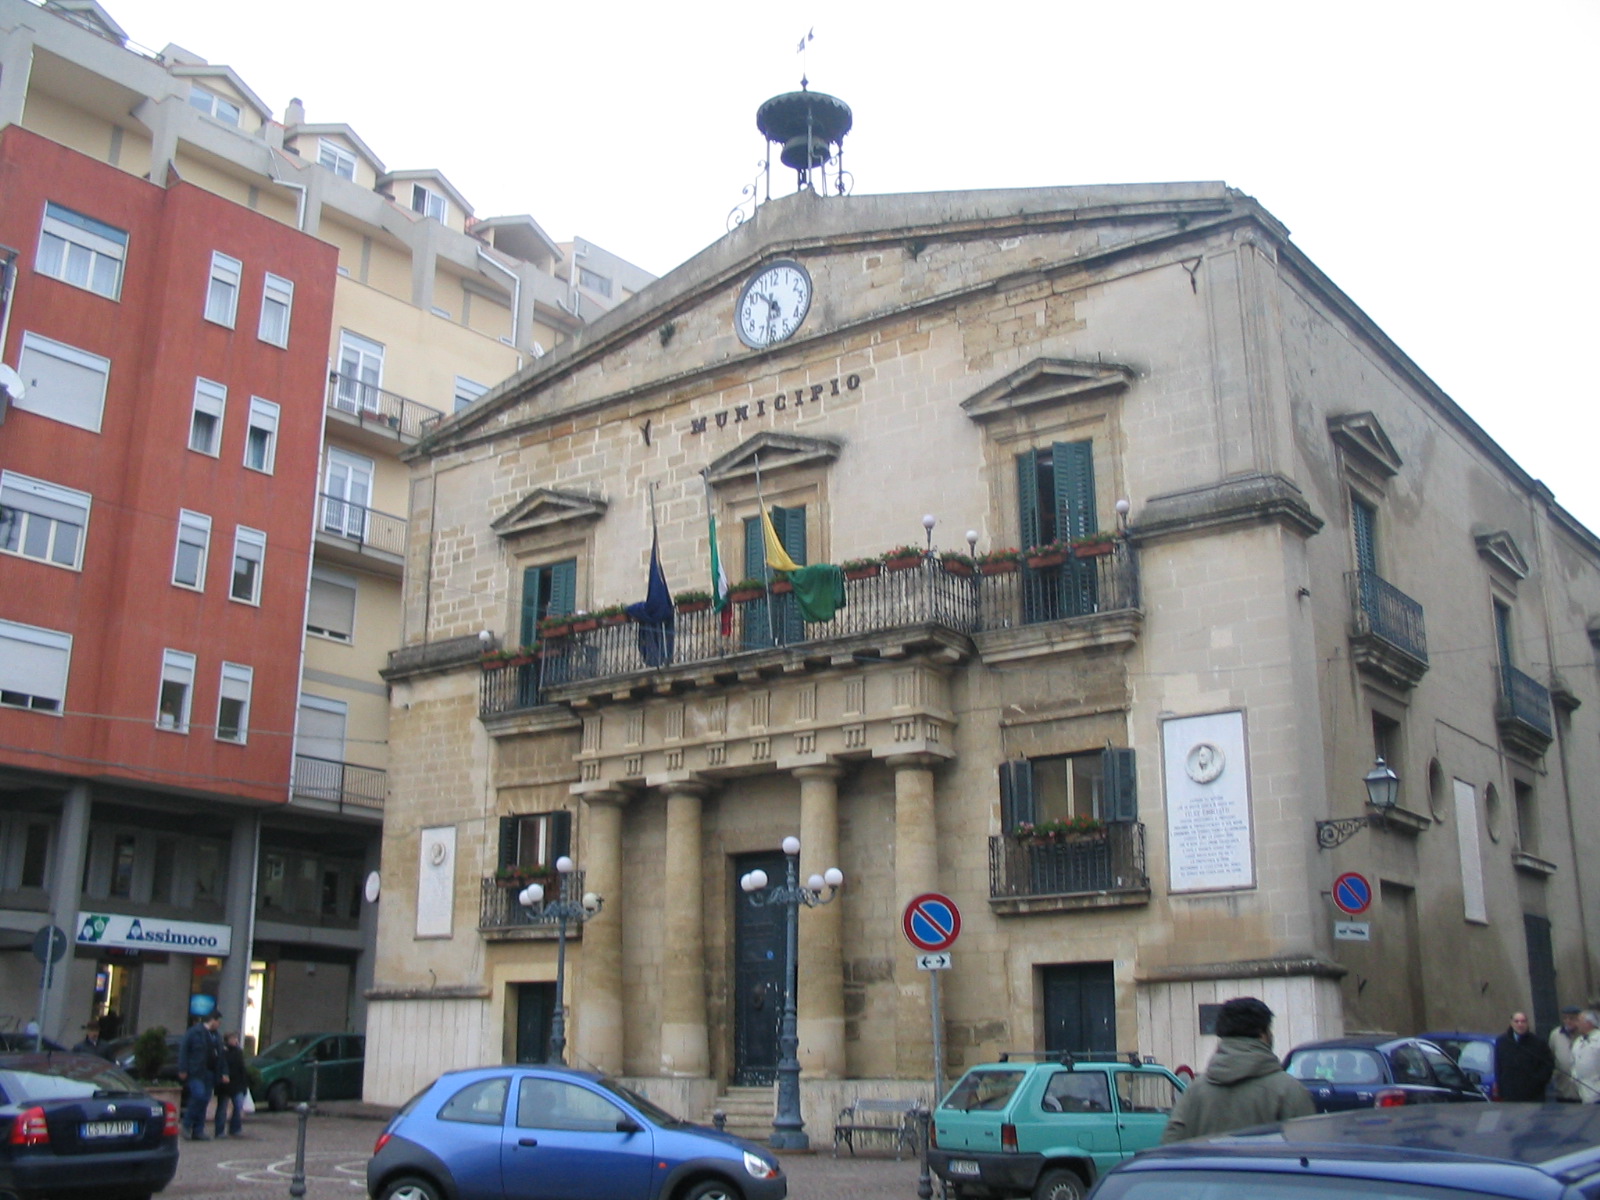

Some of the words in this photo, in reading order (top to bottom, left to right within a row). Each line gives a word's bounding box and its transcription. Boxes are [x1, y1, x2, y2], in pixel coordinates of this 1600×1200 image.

[771, 270, 779, 286] 12
[793, 278, 799, 292] 2
[760, 279, 767, 293] 11
[750, 292, 758, 306] 10
[797, 290, 803, 303] 3
[745, 308, 751, 320] 9
[793, 305, 799, 317] 4
[749, 320, 755, 332] 8
[759, 326, 764, 339] 7
[770, 324, 776, 337] 6
[783, 319, 790, 333] 5
[691, 374, 860, 434] MUNICIPIO
[126, 918, 217, 947] Assimoco
